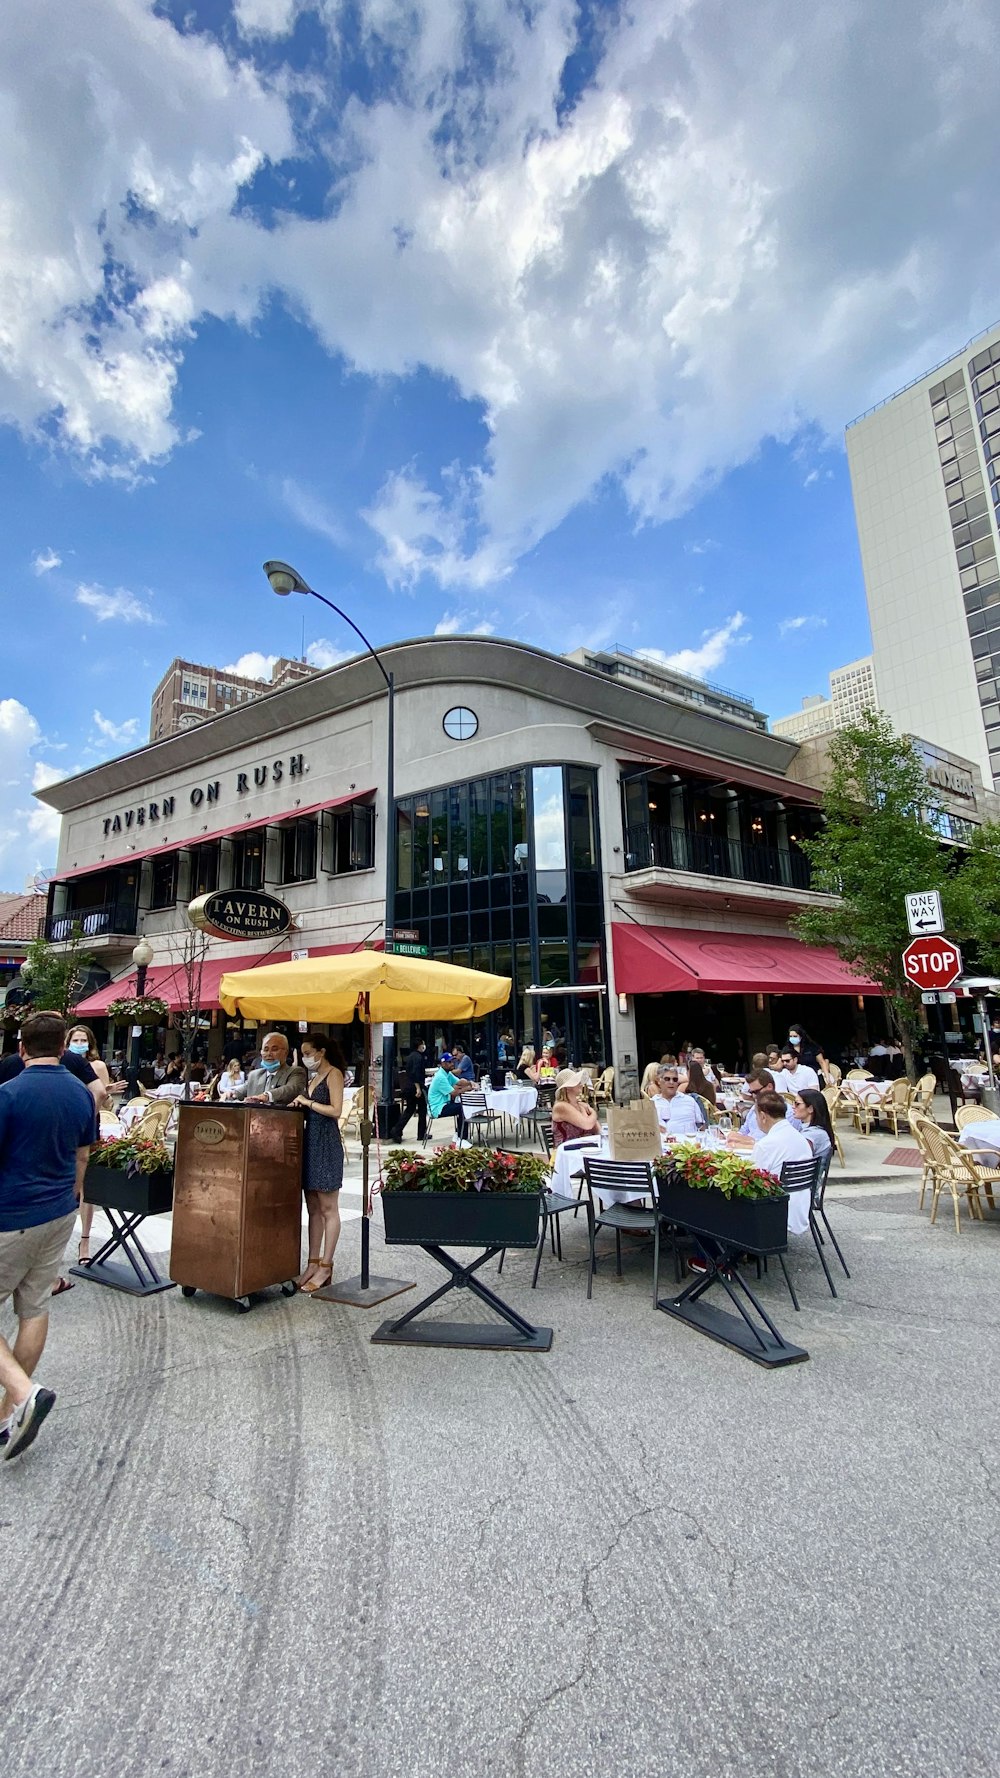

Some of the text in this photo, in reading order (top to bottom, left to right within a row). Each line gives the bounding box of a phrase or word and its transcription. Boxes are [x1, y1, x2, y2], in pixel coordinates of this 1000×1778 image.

[927, 767, 976, 799] LUXBAR
[102, 753, 304, 835] TAVERN ON RUSH
[910, 895, 935, 907] ONE
[211, 899, 281, 920] TAVERN
[911, 906, 936, 918] WAY
[226, 915, 269, 928] ON RUSH
[220, 922, 247, 936] EXCITING
[400, 944, 421, 954] BELLEVUE
[907, 951, 955, 974] STOP
